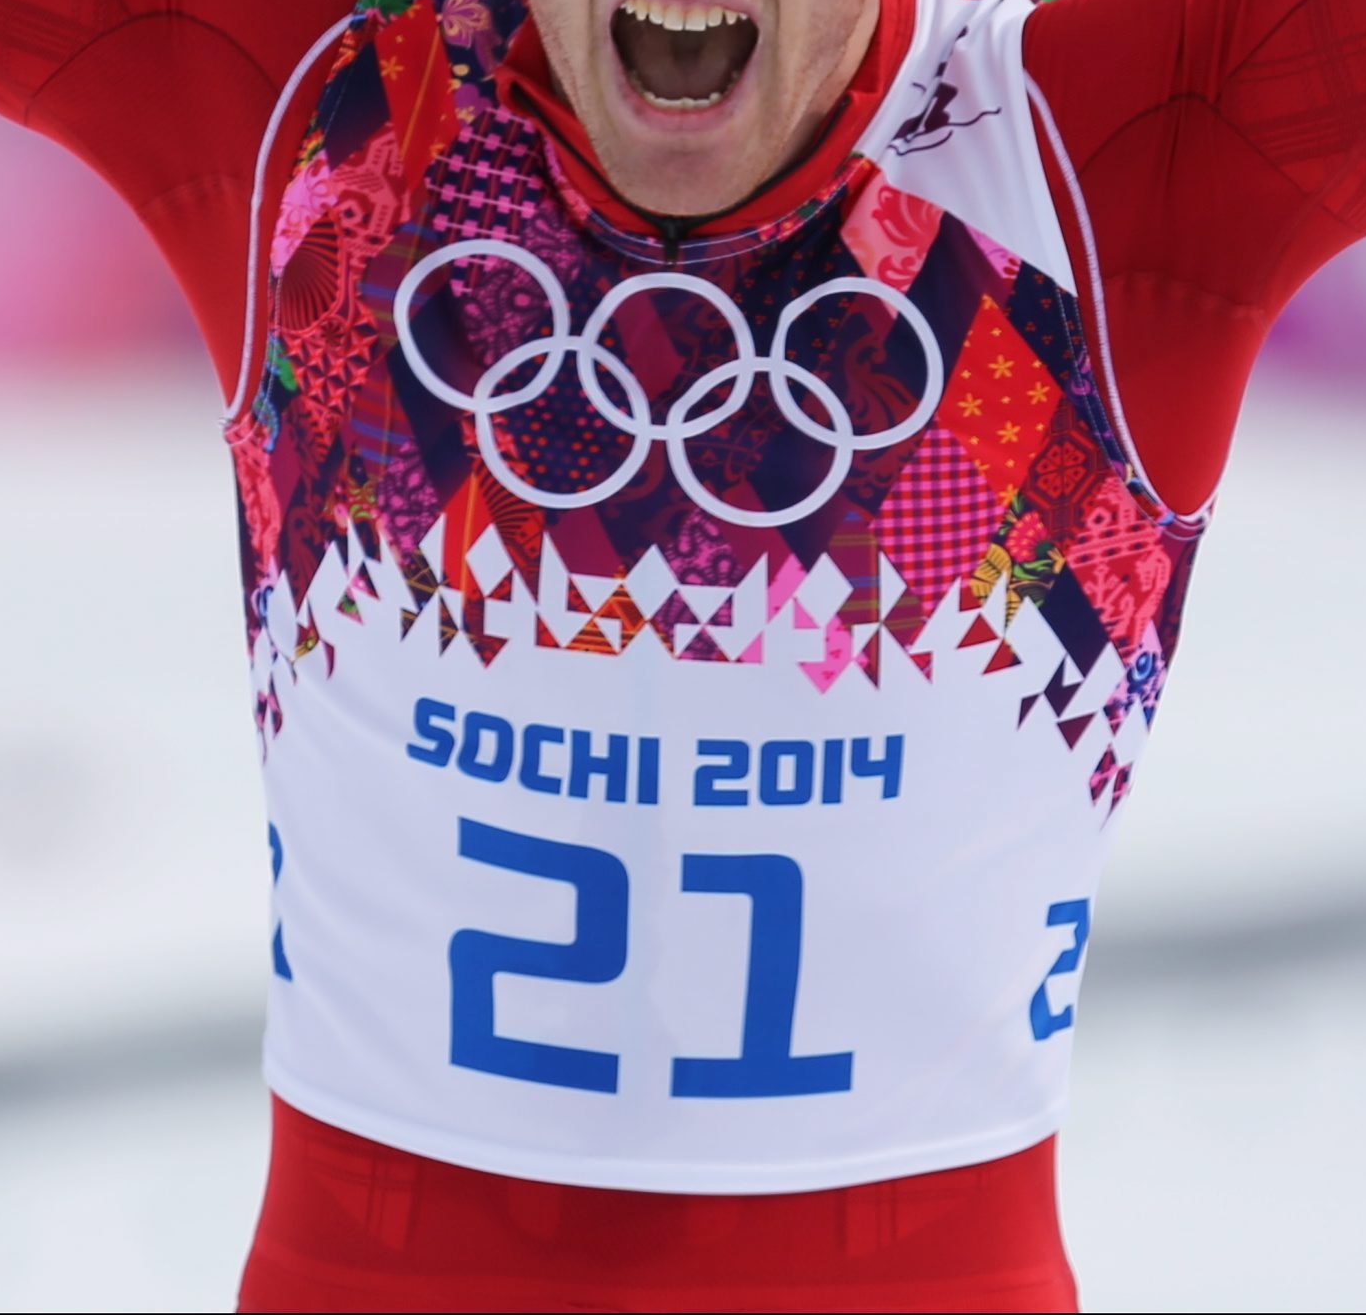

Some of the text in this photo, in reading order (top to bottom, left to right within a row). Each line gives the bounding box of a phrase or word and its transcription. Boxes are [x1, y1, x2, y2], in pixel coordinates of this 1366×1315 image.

[406, 697, 906, 808] SOCHI 2014
[447, 815, 856, 1100] 21
